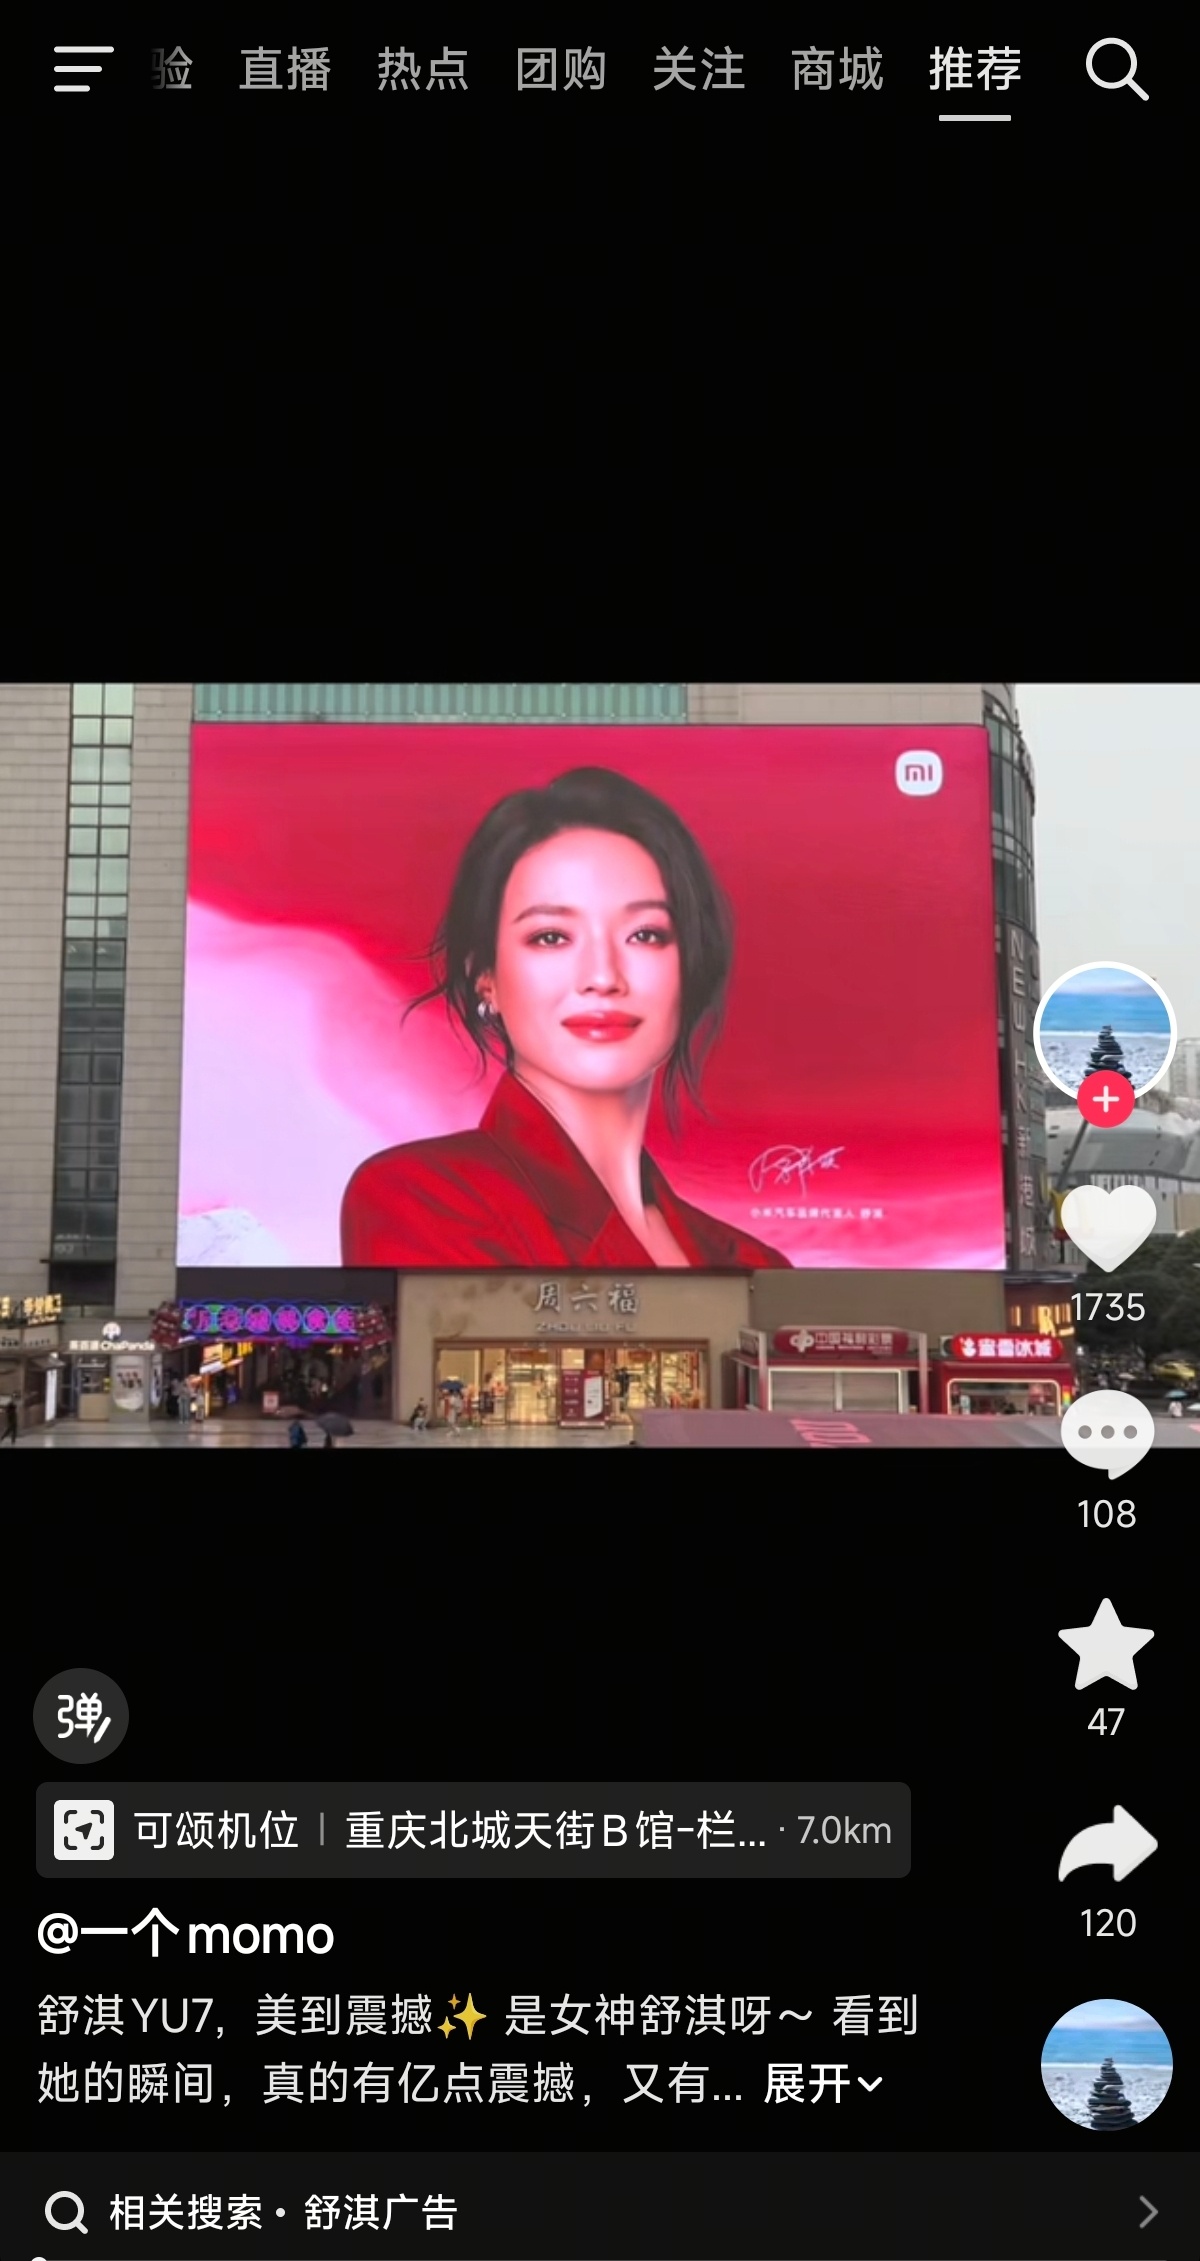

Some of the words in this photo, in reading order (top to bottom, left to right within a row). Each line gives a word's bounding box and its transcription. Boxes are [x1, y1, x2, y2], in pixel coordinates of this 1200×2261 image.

[535, 1282, 638, 1314] 周六福
[815, 1332, 893, 1345] 中国福利彩票
[977, 1338, 1052, 1358] 蜜雪冰城
